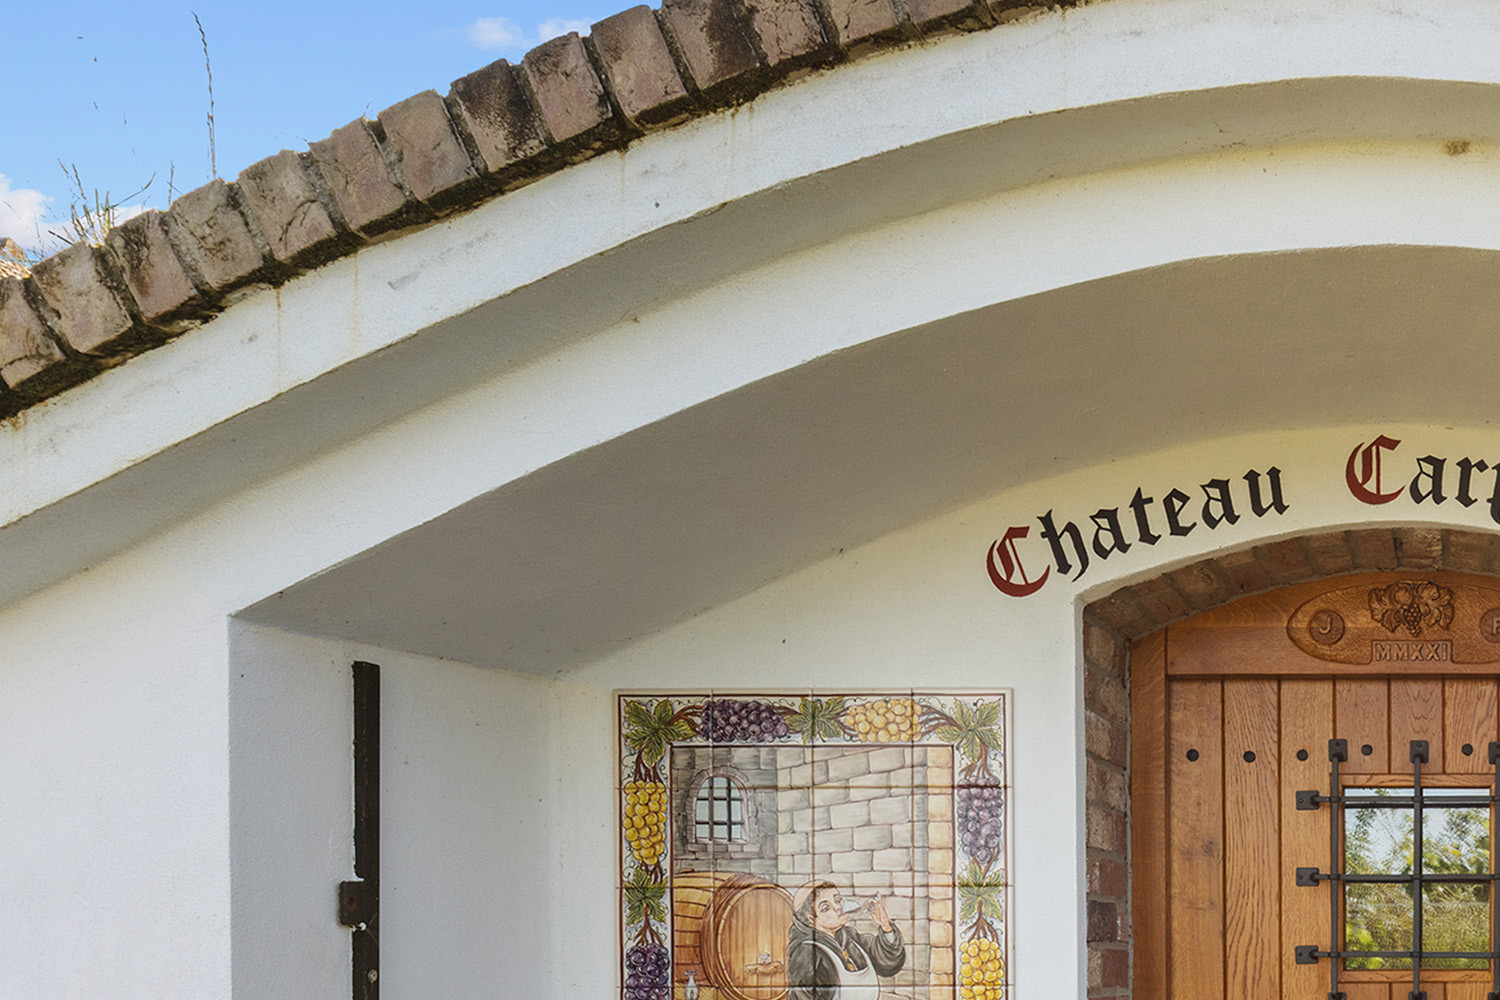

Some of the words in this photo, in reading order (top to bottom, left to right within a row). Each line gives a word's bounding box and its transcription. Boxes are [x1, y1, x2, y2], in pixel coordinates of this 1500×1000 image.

[986, 465, 1290, 598] Chateau
[1318, 617, 1333, 635] J
[1374, 642, 1449, 661] MMXXI
